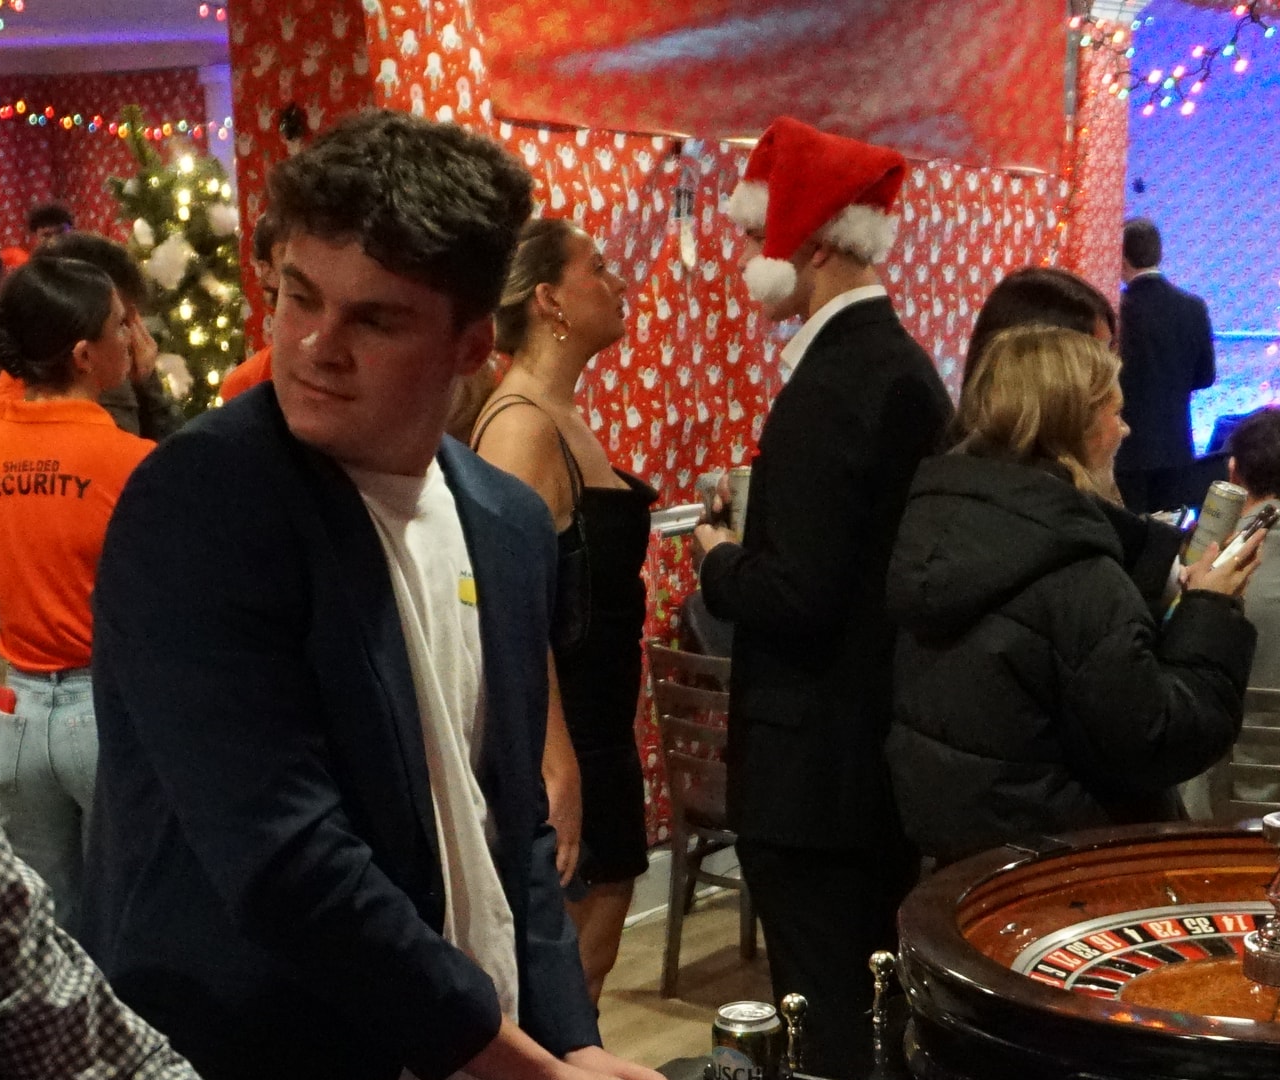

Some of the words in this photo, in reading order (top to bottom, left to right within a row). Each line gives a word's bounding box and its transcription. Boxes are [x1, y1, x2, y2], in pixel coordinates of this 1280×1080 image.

[2, 460, 60, 473] SHIELDED
[1183, 917, 1215, 934] 35
[1221, 915, 1249, 932] 14
[1123, 927, 1144, 943] 4
